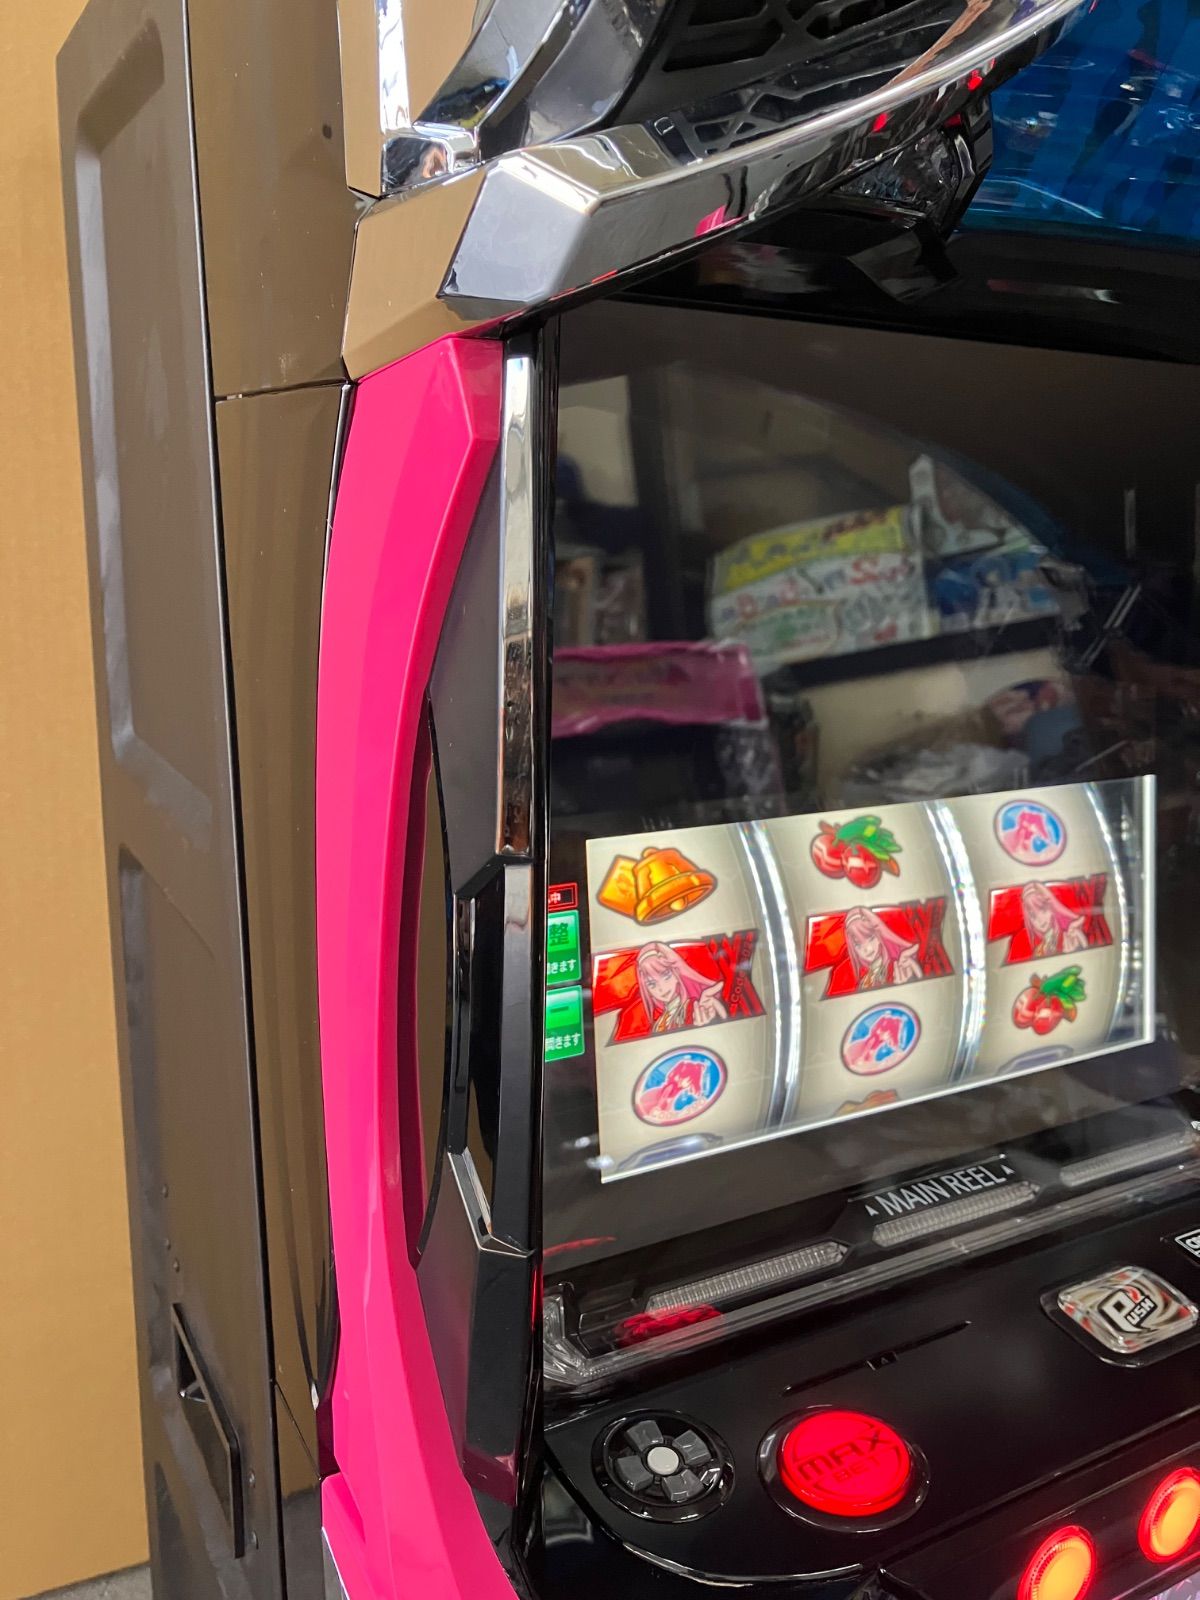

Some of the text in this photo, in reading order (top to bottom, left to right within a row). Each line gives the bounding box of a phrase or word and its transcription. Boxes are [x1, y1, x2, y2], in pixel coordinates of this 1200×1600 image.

[875, 1166, 1007, 1216] MAIN REEL
[798, 1429, 892, 1481] MAX
